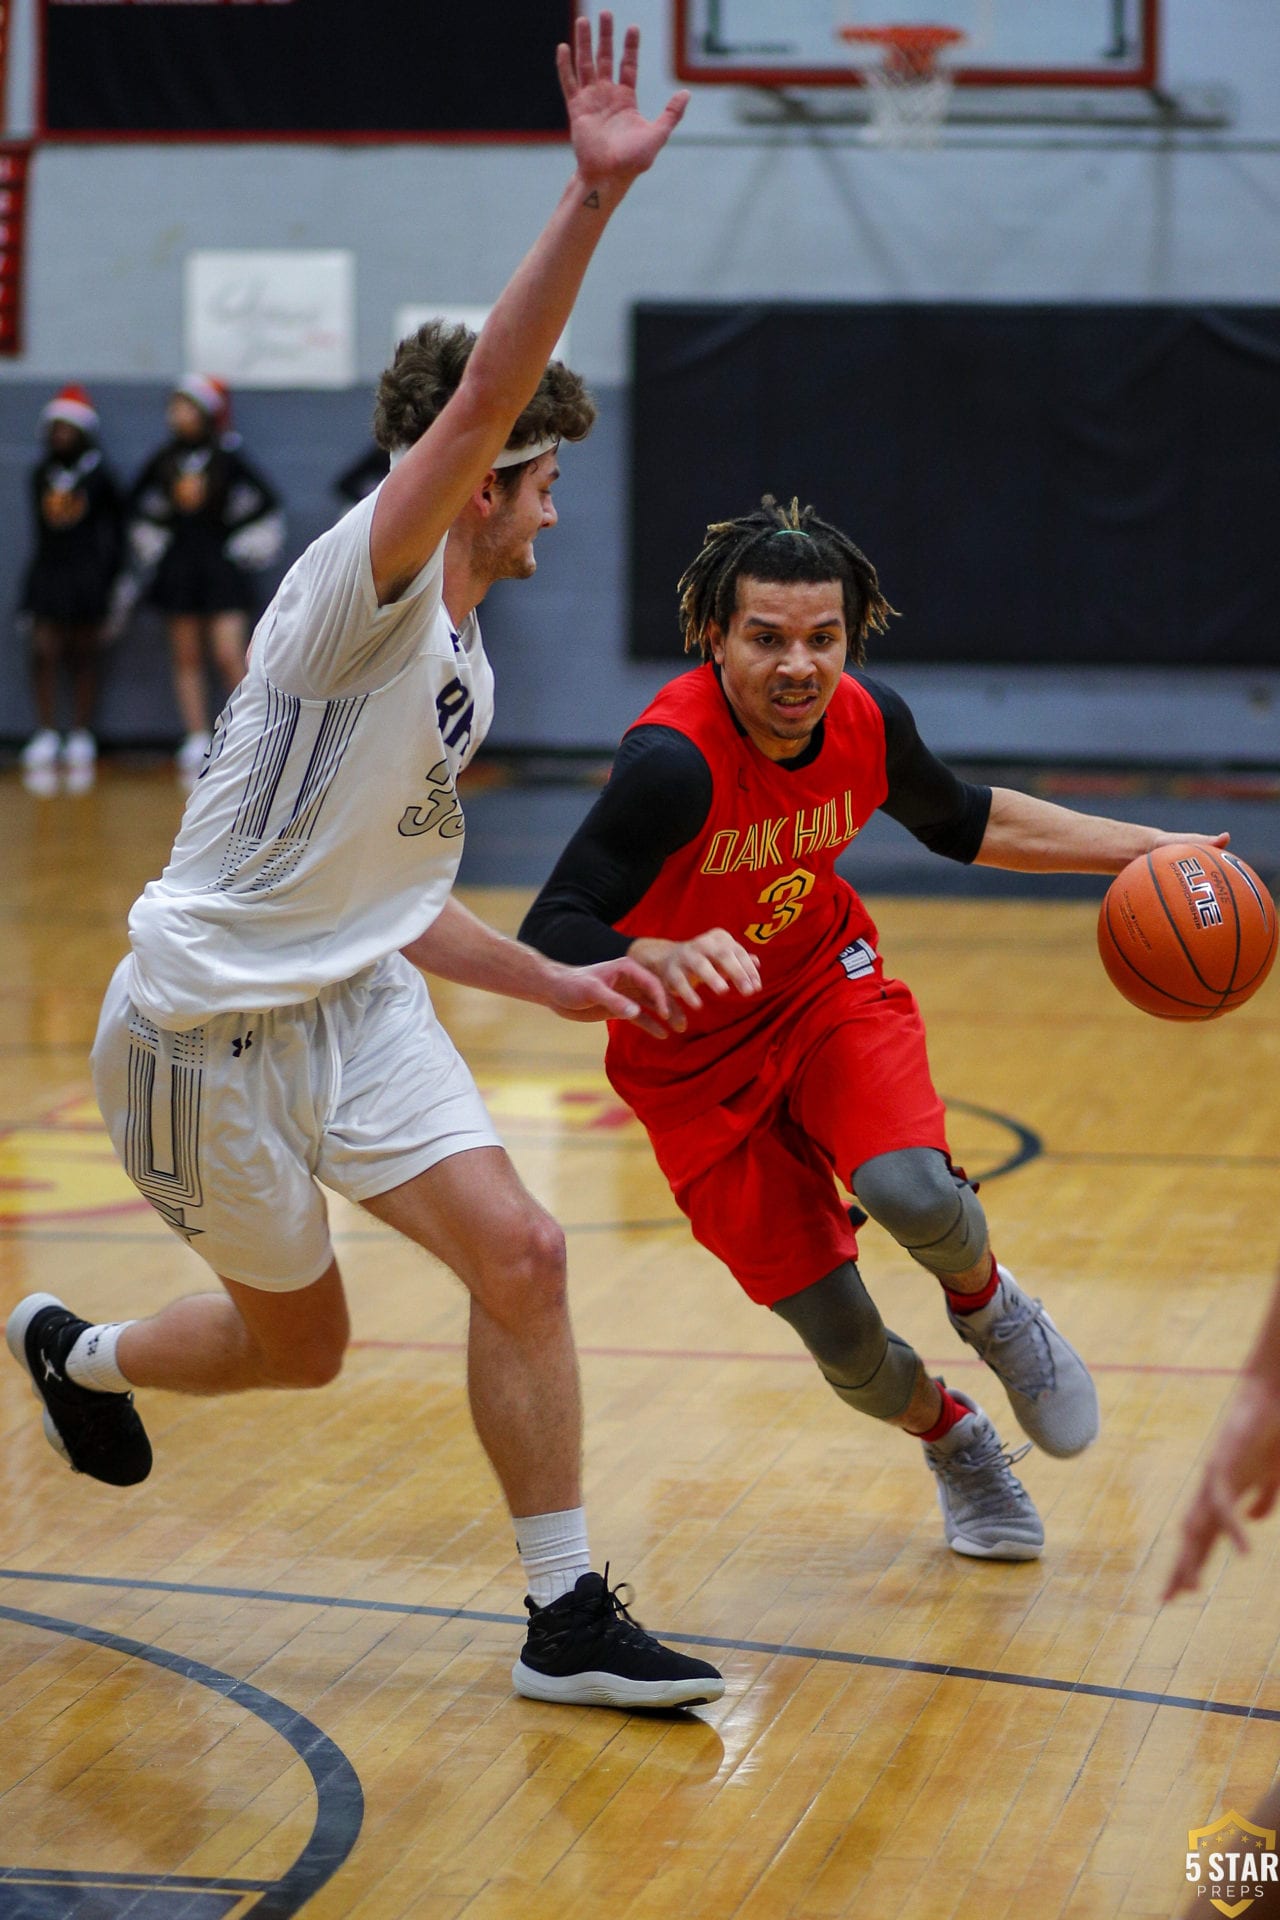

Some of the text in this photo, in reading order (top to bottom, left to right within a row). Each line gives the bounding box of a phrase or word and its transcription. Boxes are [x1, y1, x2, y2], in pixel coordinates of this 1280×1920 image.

[700, 789, 860, 875] OAK HILL
[743, 868, 816, 945] 3
[1176, 857, 1223, 929] ELITE
